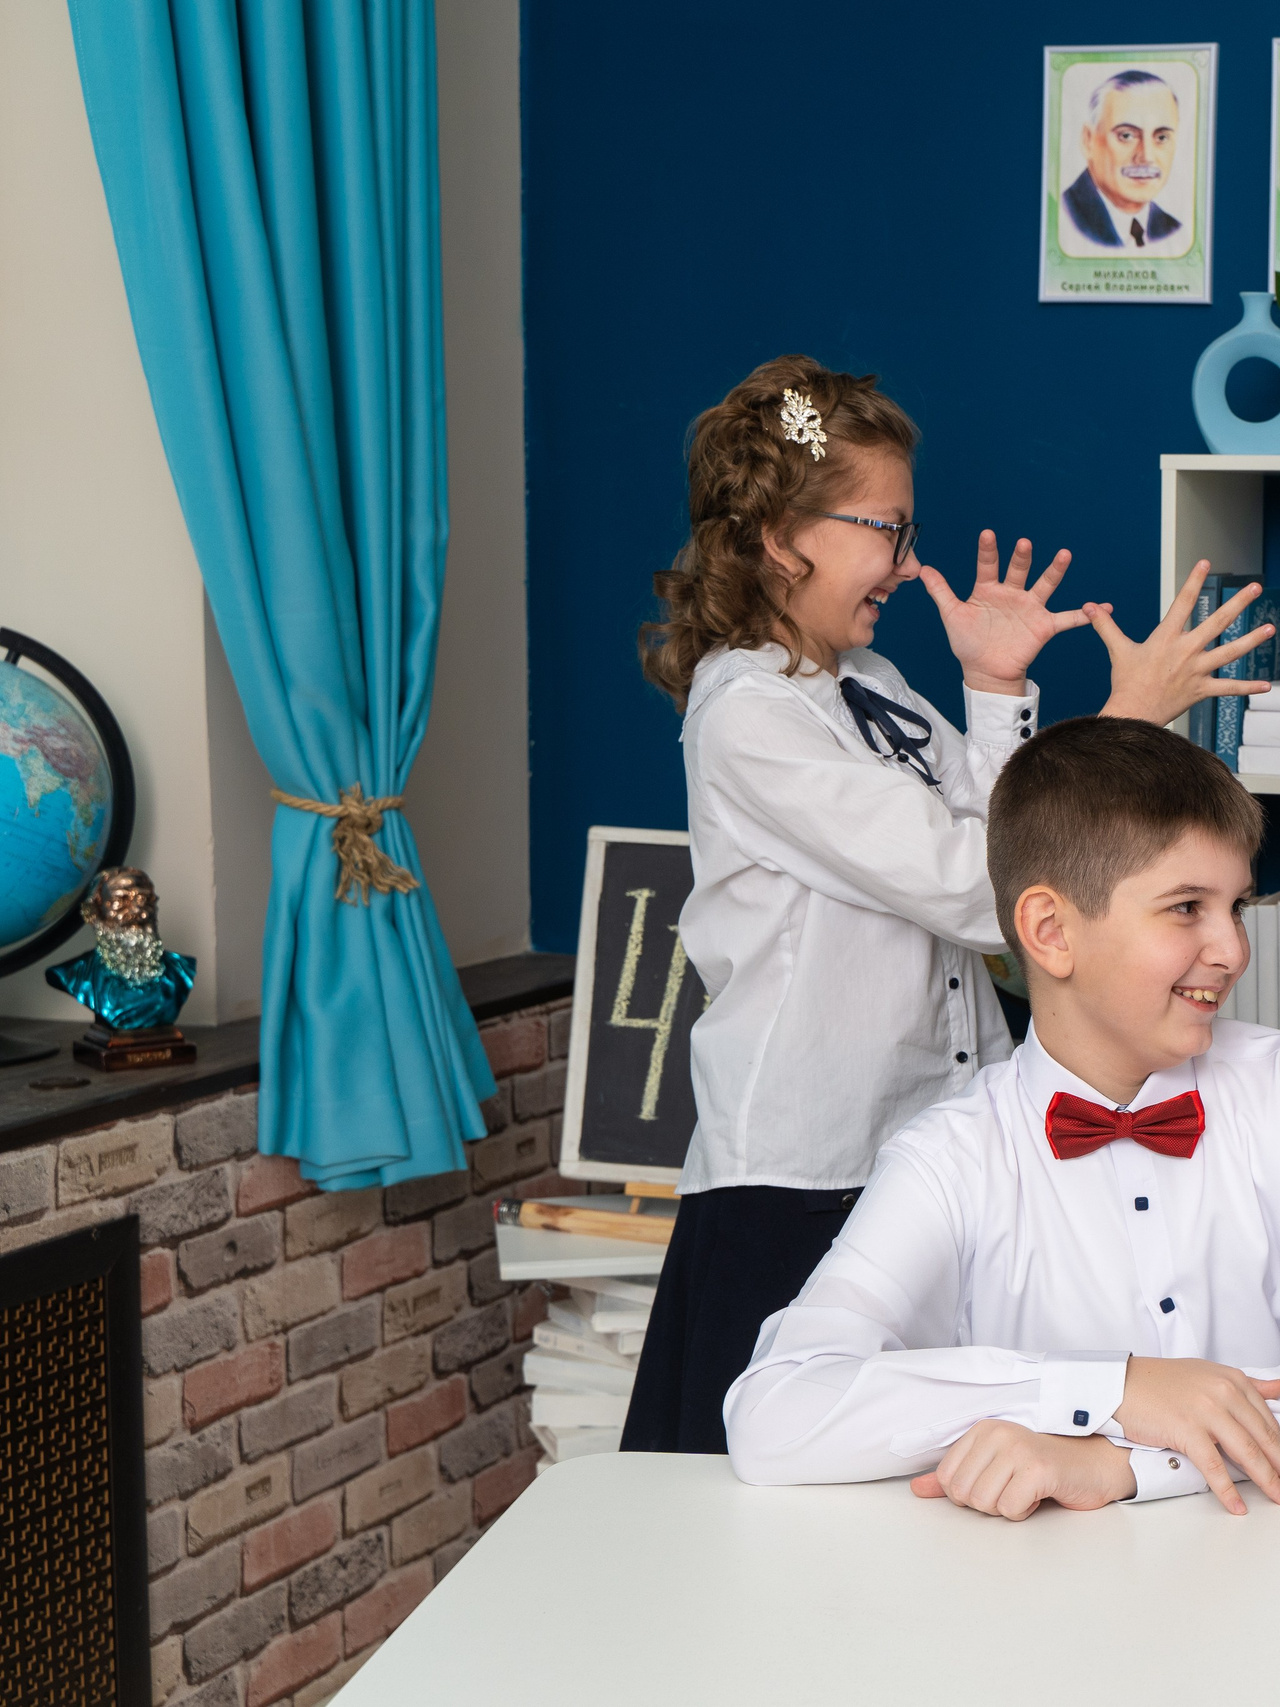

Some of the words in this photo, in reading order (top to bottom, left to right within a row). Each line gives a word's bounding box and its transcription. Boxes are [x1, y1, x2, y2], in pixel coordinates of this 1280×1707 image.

[1093, 270, 1157, 280] МИХАЛКОВ
[1061, 281, 1100, 293] Сергей
[1105, 281, 1190, 293] Владимирович
